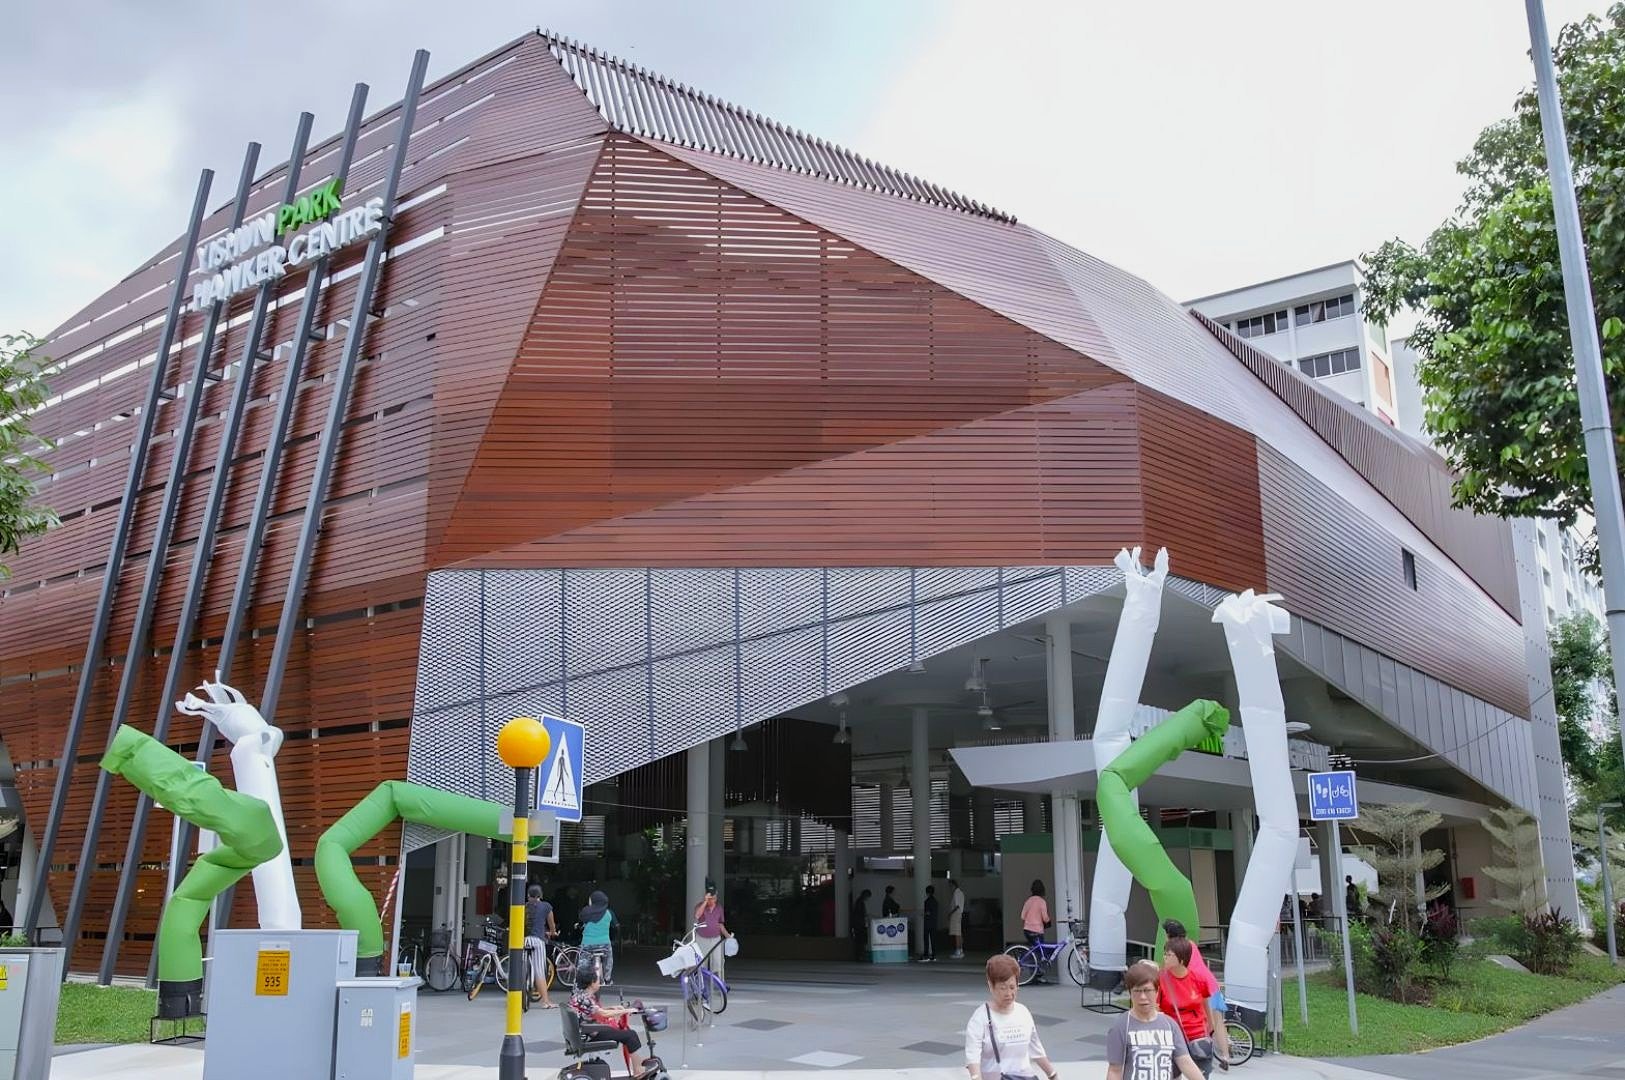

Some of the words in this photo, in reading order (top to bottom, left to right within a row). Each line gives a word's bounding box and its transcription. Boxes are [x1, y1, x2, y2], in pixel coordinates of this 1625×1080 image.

[197, 212, 276, 274] YISHUN
[277, 178, 344, 236] PARK
[192, 246, 287, 312] HAWKER
[288, 197, 384, 266] CENTRE
[264, 976, 281, 987] 935
[1128, 1029, 1174, 1046] TOKYO
